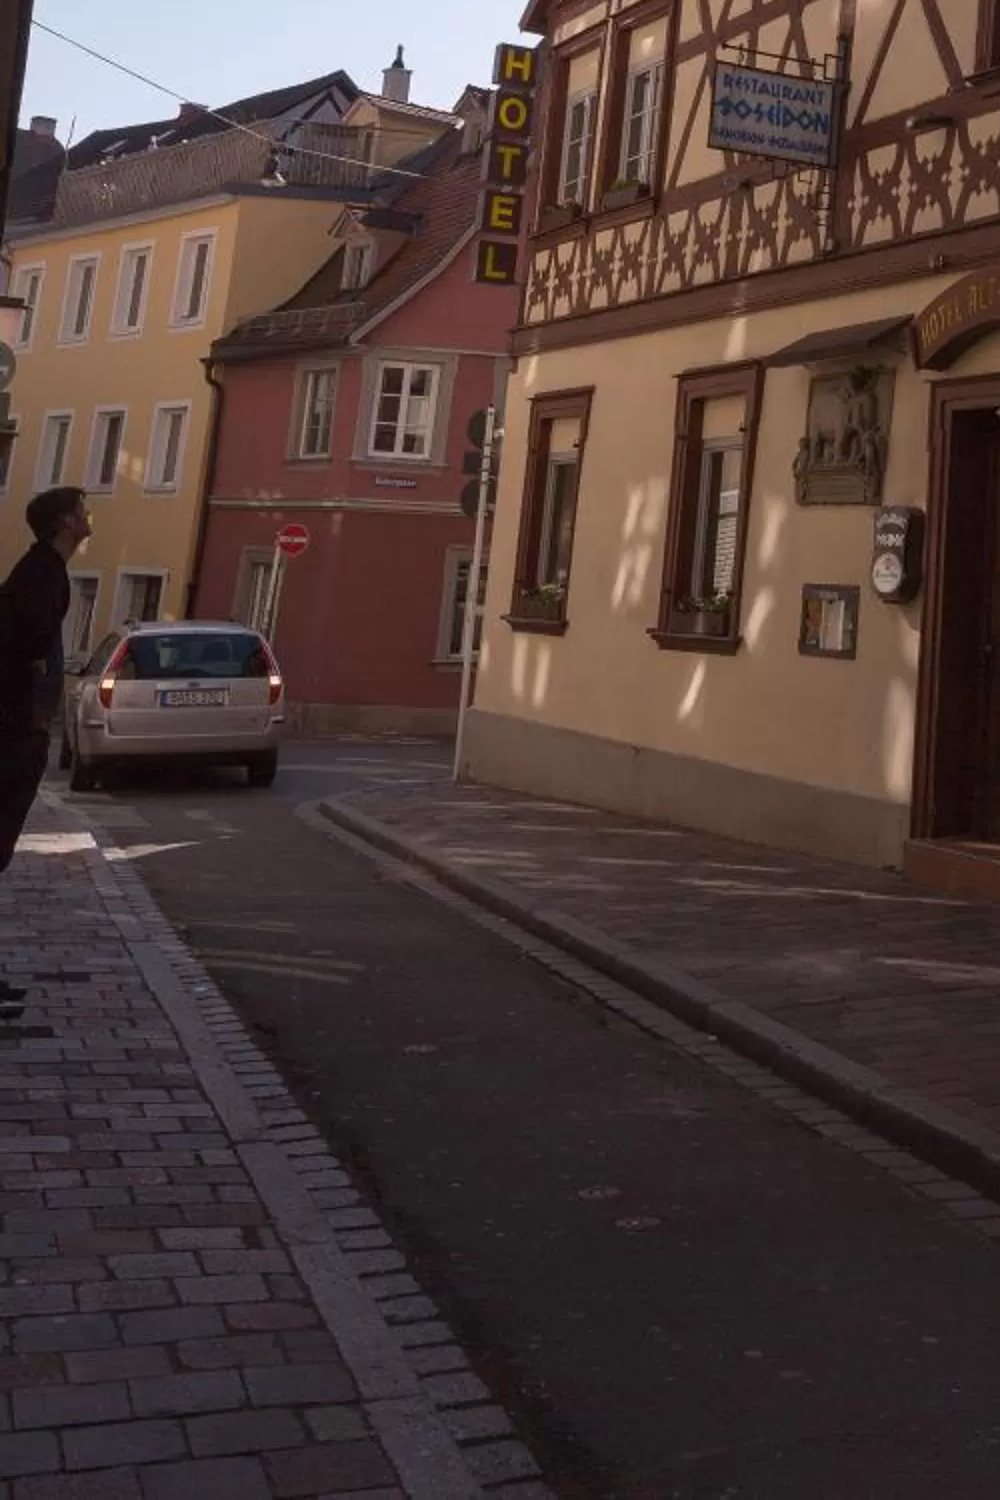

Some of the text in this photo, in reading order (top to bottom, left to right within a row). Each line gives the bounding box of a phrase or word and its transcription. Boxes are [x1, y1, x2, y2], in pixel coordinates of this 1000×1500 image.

[723, 73, 825, 105] RESTAURANT
[716, 96, 829, 134] POSEIDON
[484, 50, 533, 280] HOTEL
[920, 300, 963, 349] HOTEL
